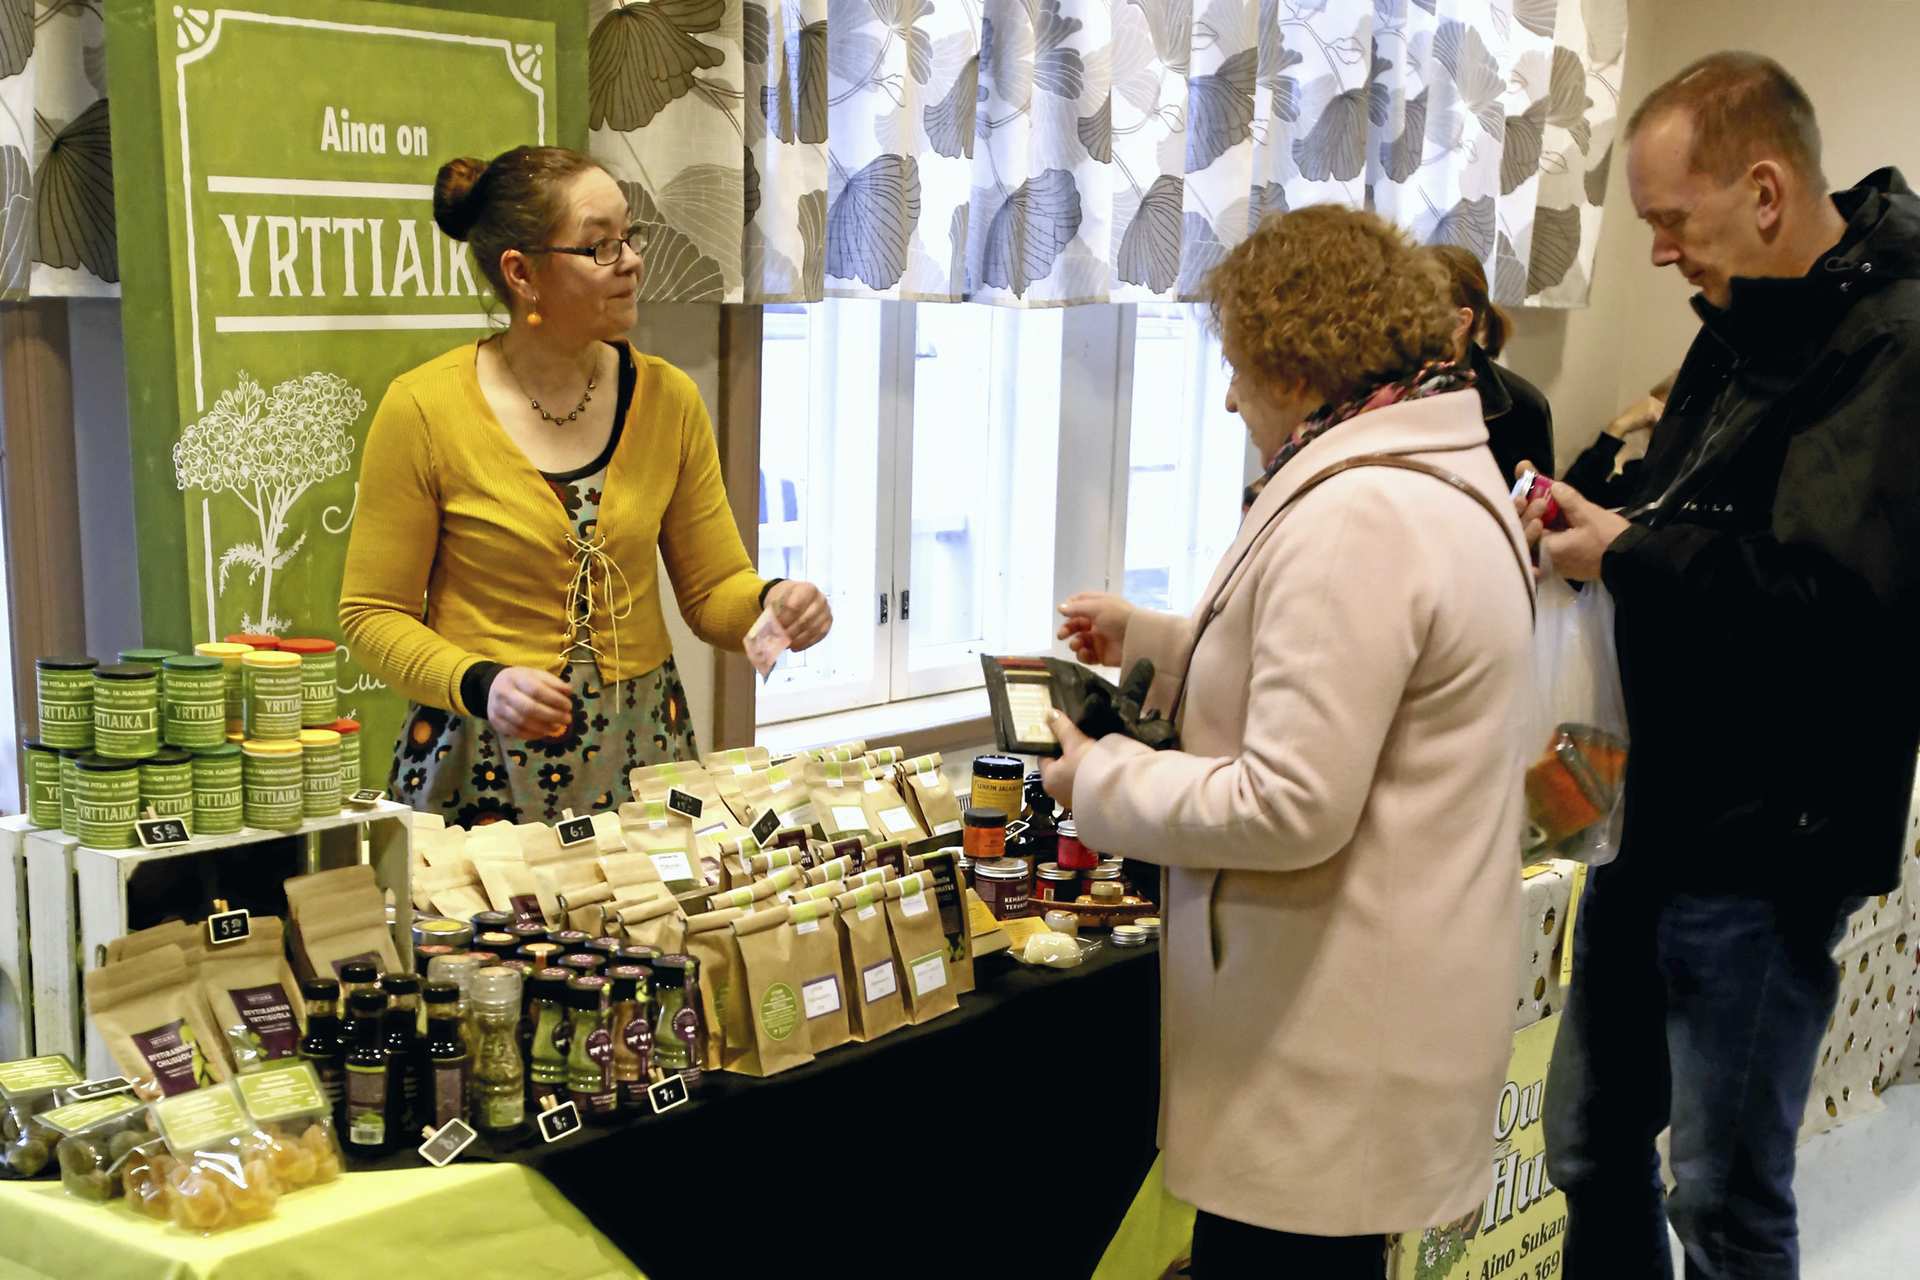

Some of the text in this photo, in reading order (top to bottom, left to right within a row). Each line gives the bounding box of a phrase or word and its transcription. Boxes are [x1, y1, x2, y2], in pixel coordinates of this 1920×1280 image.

[320, 106, 428, 156] Aina on
[218, 213, 494, 297] YRTTIAIK
[1480, 1249, 1516, 1280] Aino
